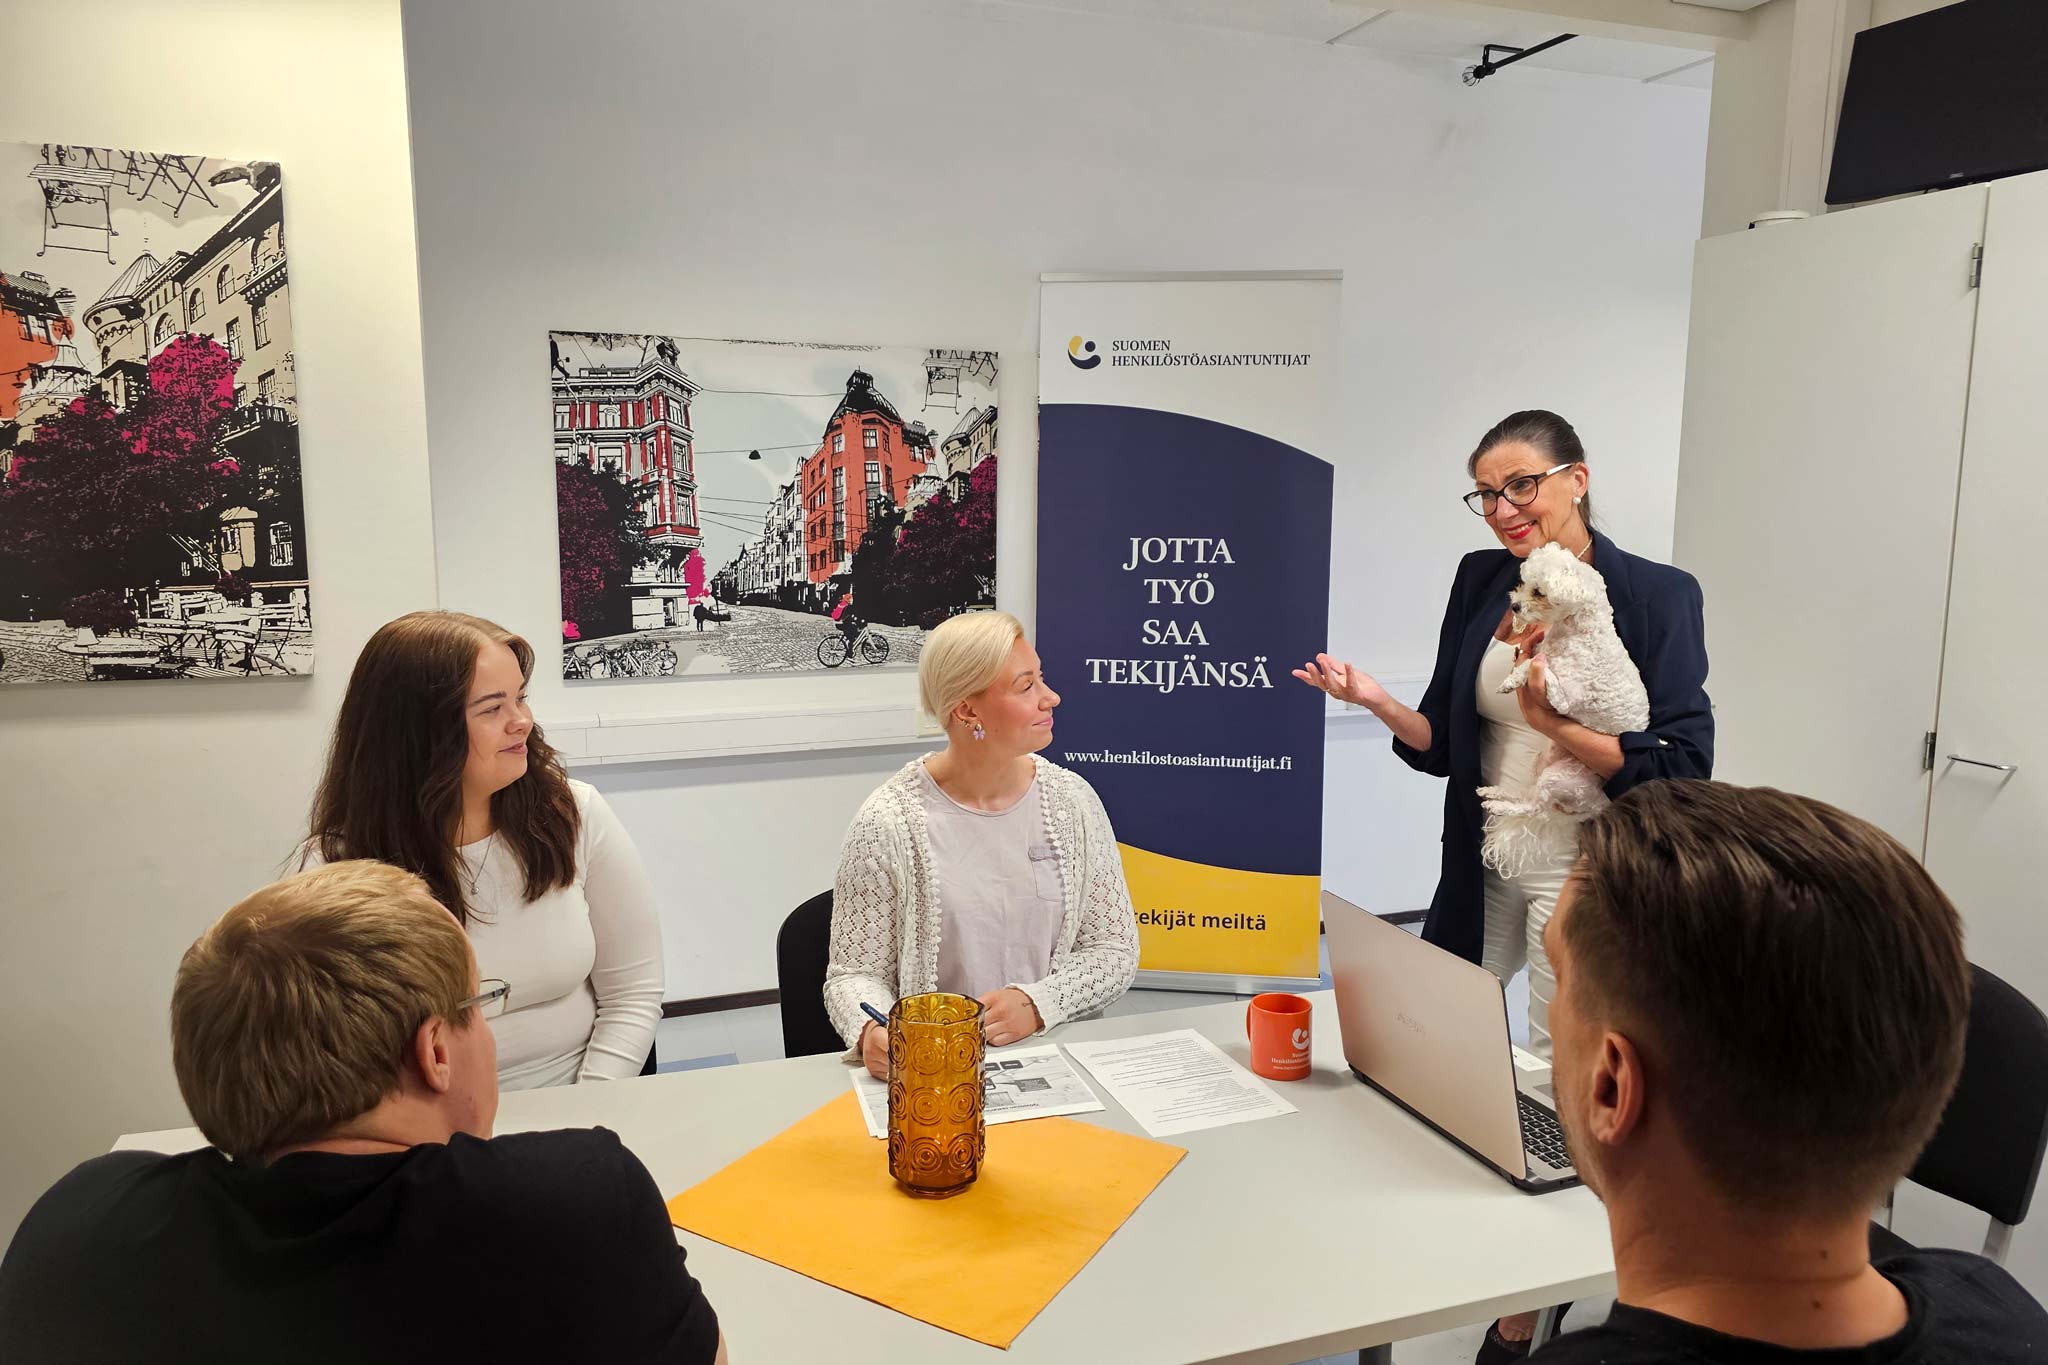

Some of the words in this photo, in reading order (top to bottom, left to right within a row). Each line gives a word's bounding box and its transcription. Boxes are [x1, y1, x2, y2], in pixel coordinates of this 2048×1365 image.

[1112, 340, 1171, 351] SUOMEN
[1112, 353, 1311, 367] HENKILÖSTÖASIANTUNTIJAT
[1122, 537, 1235, 571] JOTTA
[1144, 572, 1215, 605] TYÖ
[1142, 619, 1209, 645] SAA
[1086, 654, 1274, 694] TEKIJÄNSÄ
[1064, 750, 1292, 773] www.henkilostoasiantuntijat.fi
[1202, 913, 1266, 931] meiltä
